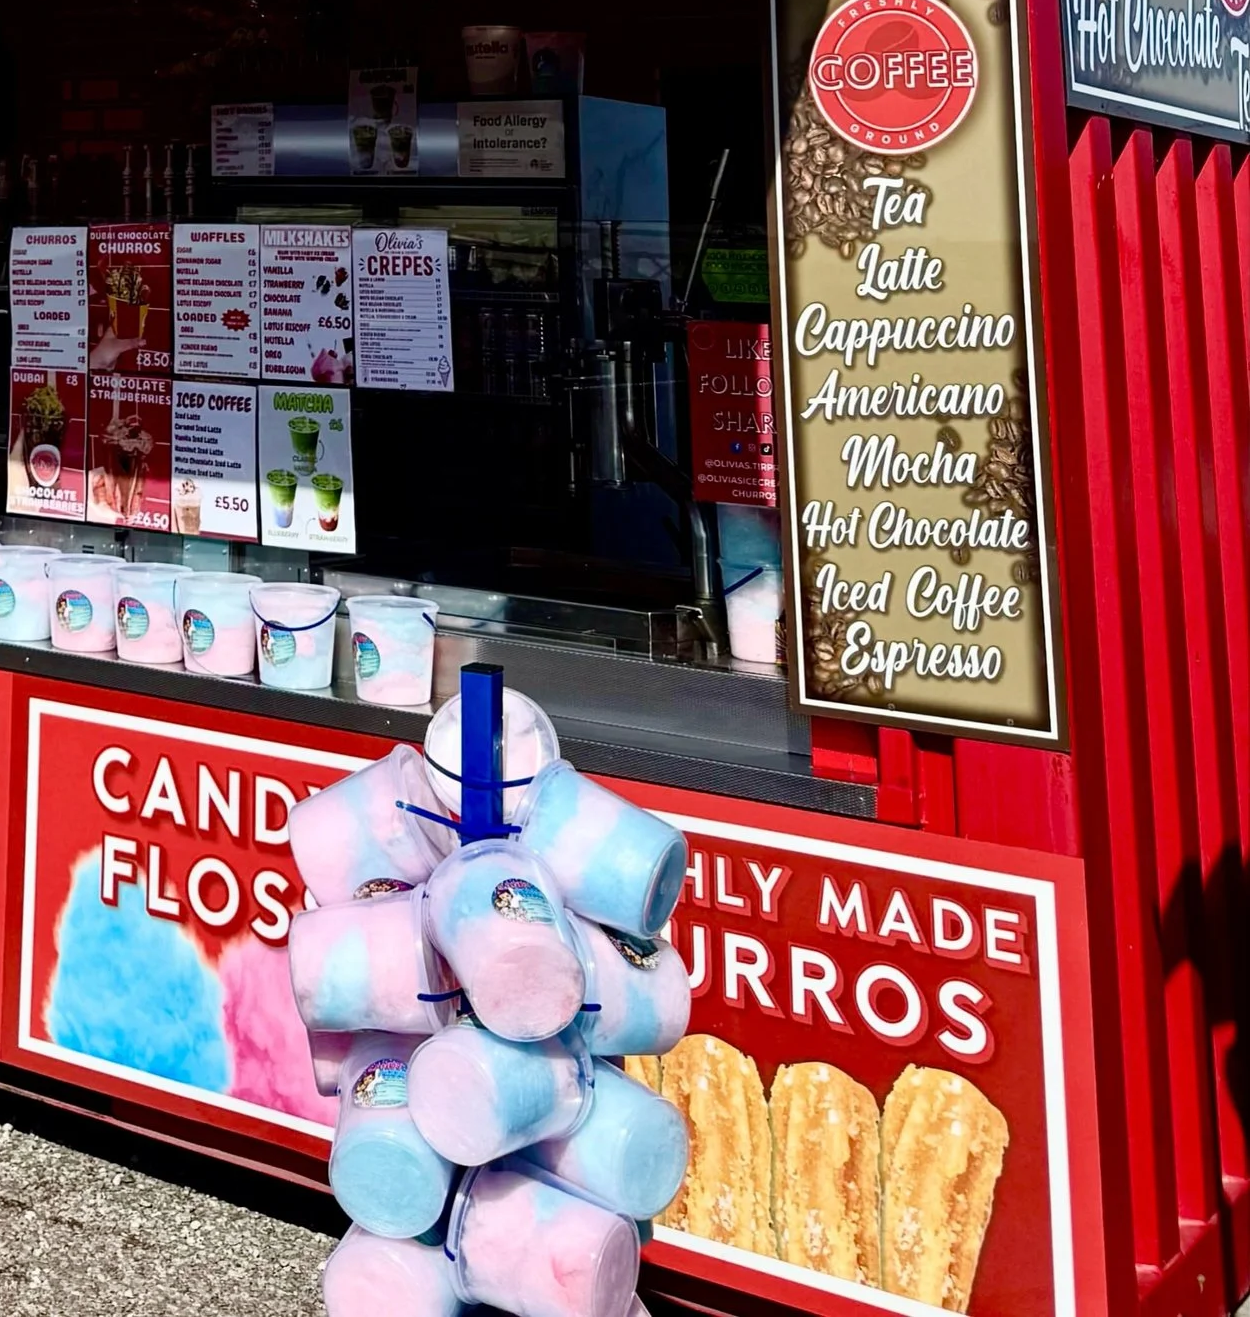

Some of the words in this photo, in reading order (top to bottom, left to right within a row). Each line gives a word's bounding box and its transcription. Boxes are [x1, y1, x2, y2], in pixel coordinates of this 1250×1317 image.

[811, 50, 974, 91] COFFEE
[473, 115, 502, 127] Food
[504, 115, 547, 129] Allergy
[850, 121, 941, 145] GROUND
[473, 137, 547, 149] Intolerance?
[863, 178, 927, 231] Tea
[26, 235, 77, 245] CHURROS
[90, 232, 116, 240] DUBAI
[117, 232, 170, 240] CHOCOLATE
[190, 232, 246, 243] WAFFLES
[263, 229, 350, 247] MILKSHAKES
[375, 232, 424, 253] Olivia's
[98, 242, 162, 254] CHURROS
[263, 266, 294, 275] VANILLA
[367, 255, 434, 277] CREPES
[856, 243, 944, 301] Latte
[263, 281, 305, 290] STRAWBERRY
[263, 294, 302, 303] CHOCOLATE
[34, 311, 71, 321] LOADED
[176, 312, 217, 323] LOADED
[263, 307, 293, 317] BANANA
[264, 322, 284, 331] LOTUS
[284, 323, 311, 332] BISCOFF
[318, 316, 350, 330] £6.50
[264, 336, 295, 346] NUTELLA
[795, 302, 1016, 367] Cappuccino
[265, 350, 282, 359] OREO
[725, 339, 773, 361] LIKE
[137, 353, 170, 367] £8.50
[265, 364, 306, 375] BUBBLEGUM
[13, 373, 45, 383] DUBAI
[66, 375, 78, 386] £8
[93, 376, 166, 392] CHOCOLATE
[699, 373, 774, 398] FOLLO
[90, 389, 171, 405] STRAWBERRIES
[176, 392, 205, 409] ICED
[208, 394, 252, 413] COFFEE
[273, 391, 334, 414] MATCHA
[800, 369, 1004, 421] Americano
[713, 411, 777, 434] SHAR
[841, 434, 977, 488] Mocha
[697, 473, 780, 488] @OLIVIASICECRE
[732, 489, 777, 501] CHURROS
[215, 496, 249, 512] £5.50
[133, 512, 169, 529] £6.50
[801, 501, 862, 548] Hot
[868, 501, 1030, 549] Chocolate
[816, 562, 893, 614] Iced
[906, 566, 1021, 631] Coffee
[841, 620, 1001, 690] Espresso
[93, 744, 322, 851] CAND
[101, 833, 318, 946] FLOS
[818, 876, 1029, 974] MADE
[660, 917, 994, 1064] URROS
